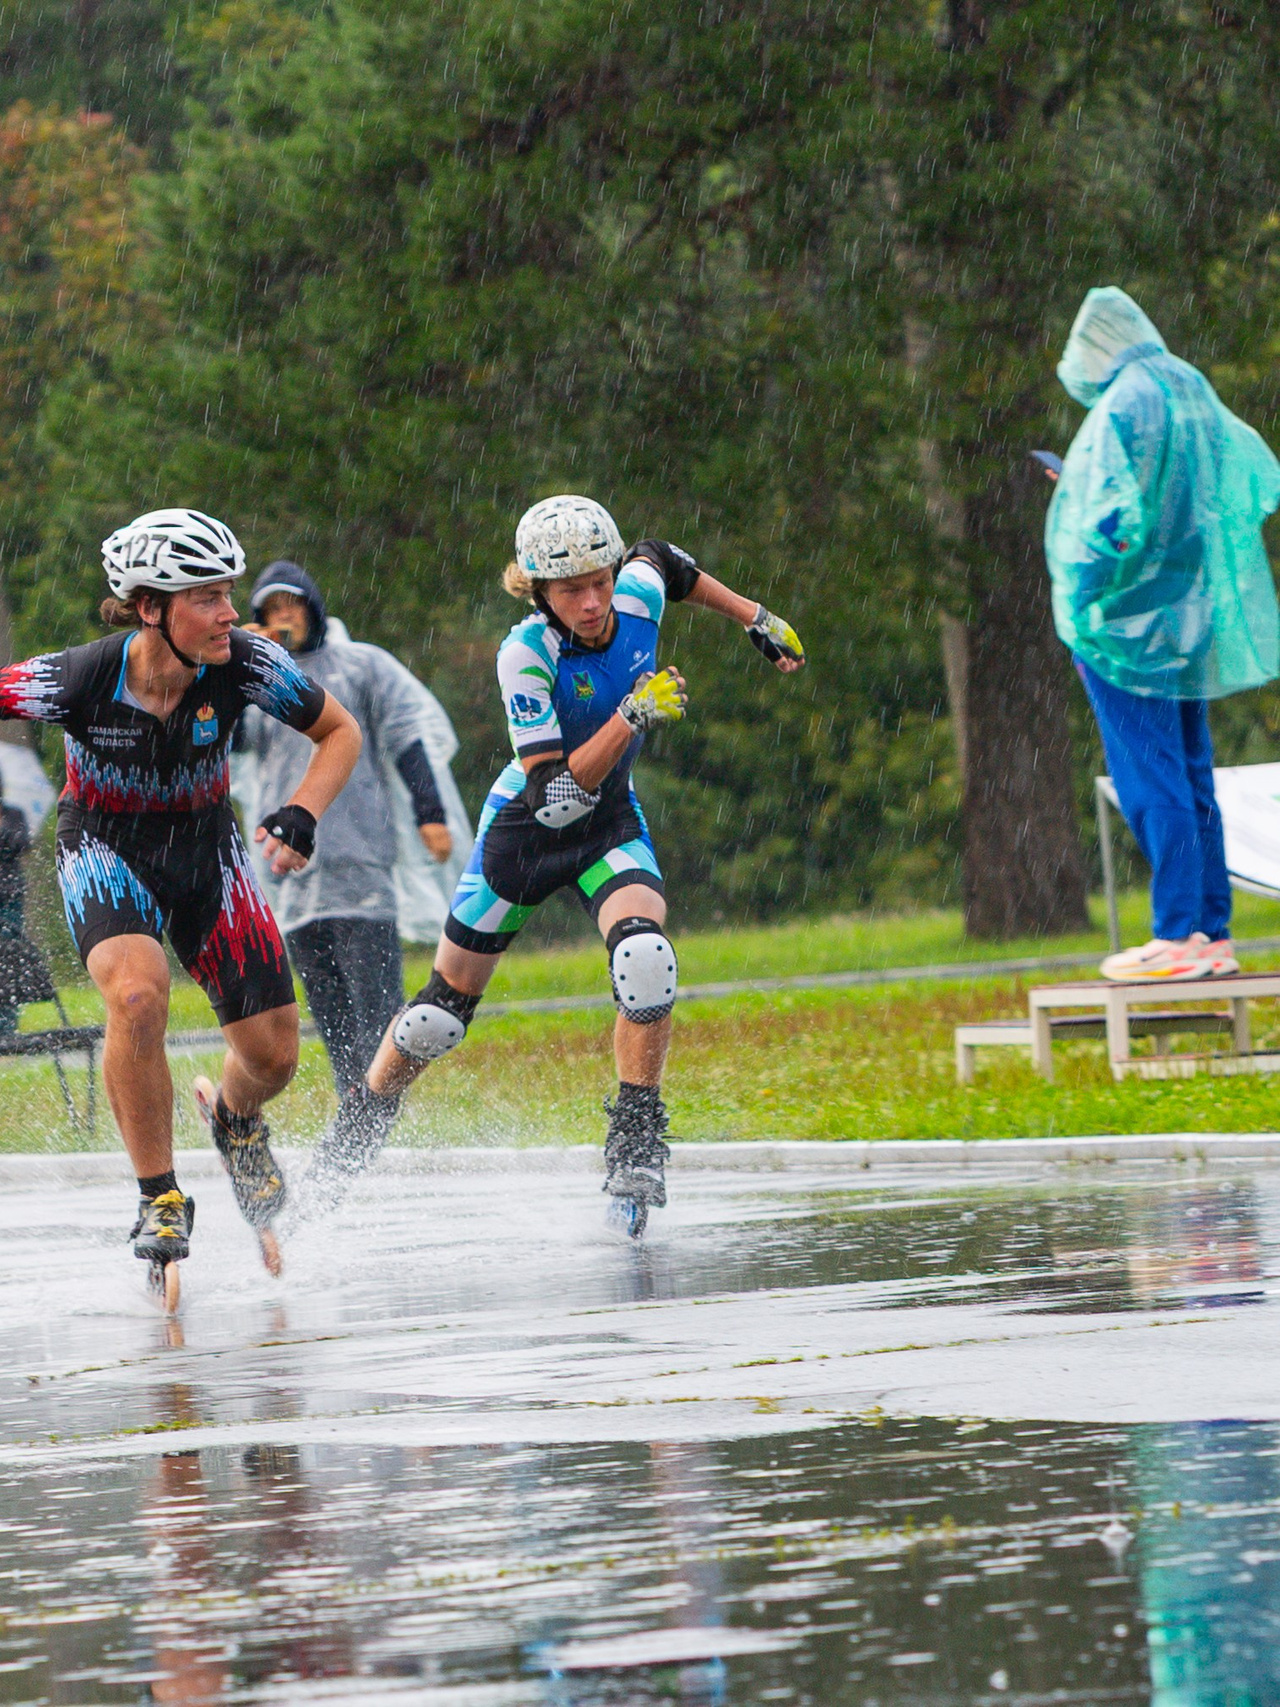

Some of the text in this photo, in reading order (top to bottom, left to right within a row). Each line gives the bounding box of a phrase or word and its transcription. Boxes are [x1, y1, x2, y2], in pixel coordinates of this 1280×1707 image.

[122, 533, 168, 568] 127
[87, 726, 142, 736] САМАРСКАЯ
[93, 736, 136, 747] ОБЛАСТЬ
